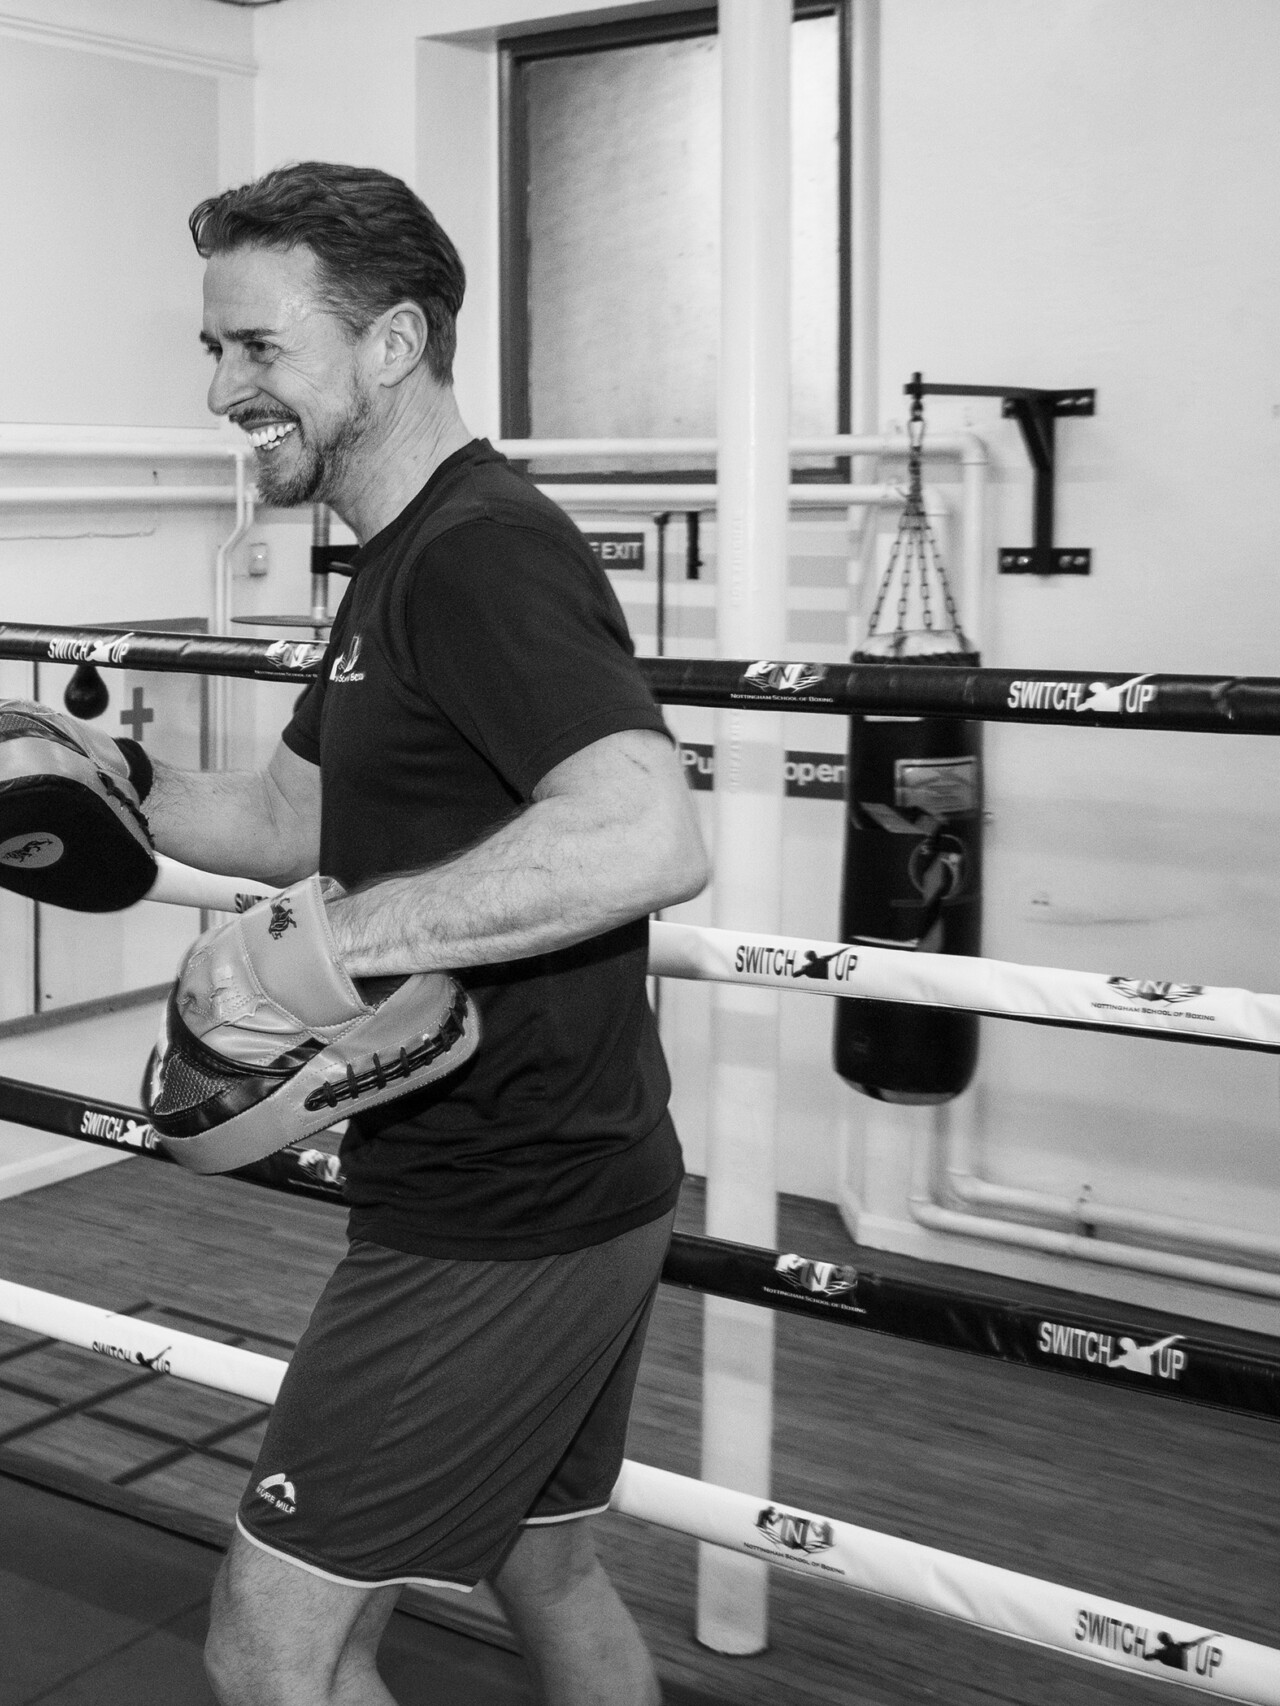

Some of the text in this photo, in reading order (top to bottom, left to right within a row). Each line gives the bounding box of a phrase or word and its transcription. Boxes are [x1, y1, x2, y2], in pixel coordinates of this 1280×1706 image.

[601, 541, 642, 560] EXIT
[48, 638, 130, 663] SWITCH UP
[1007, 680, 1158, 713] SWITCH UP
[680, 749, 713, 775] Pu
[735, 945, 858, 981] SWITCH UP
[80, 1111, 124, 1141] SWITCH
[1037, 1321, 1187, 1380] SWITCH UP
[1075, 1609, 1223, 1678] SWITCH UP
